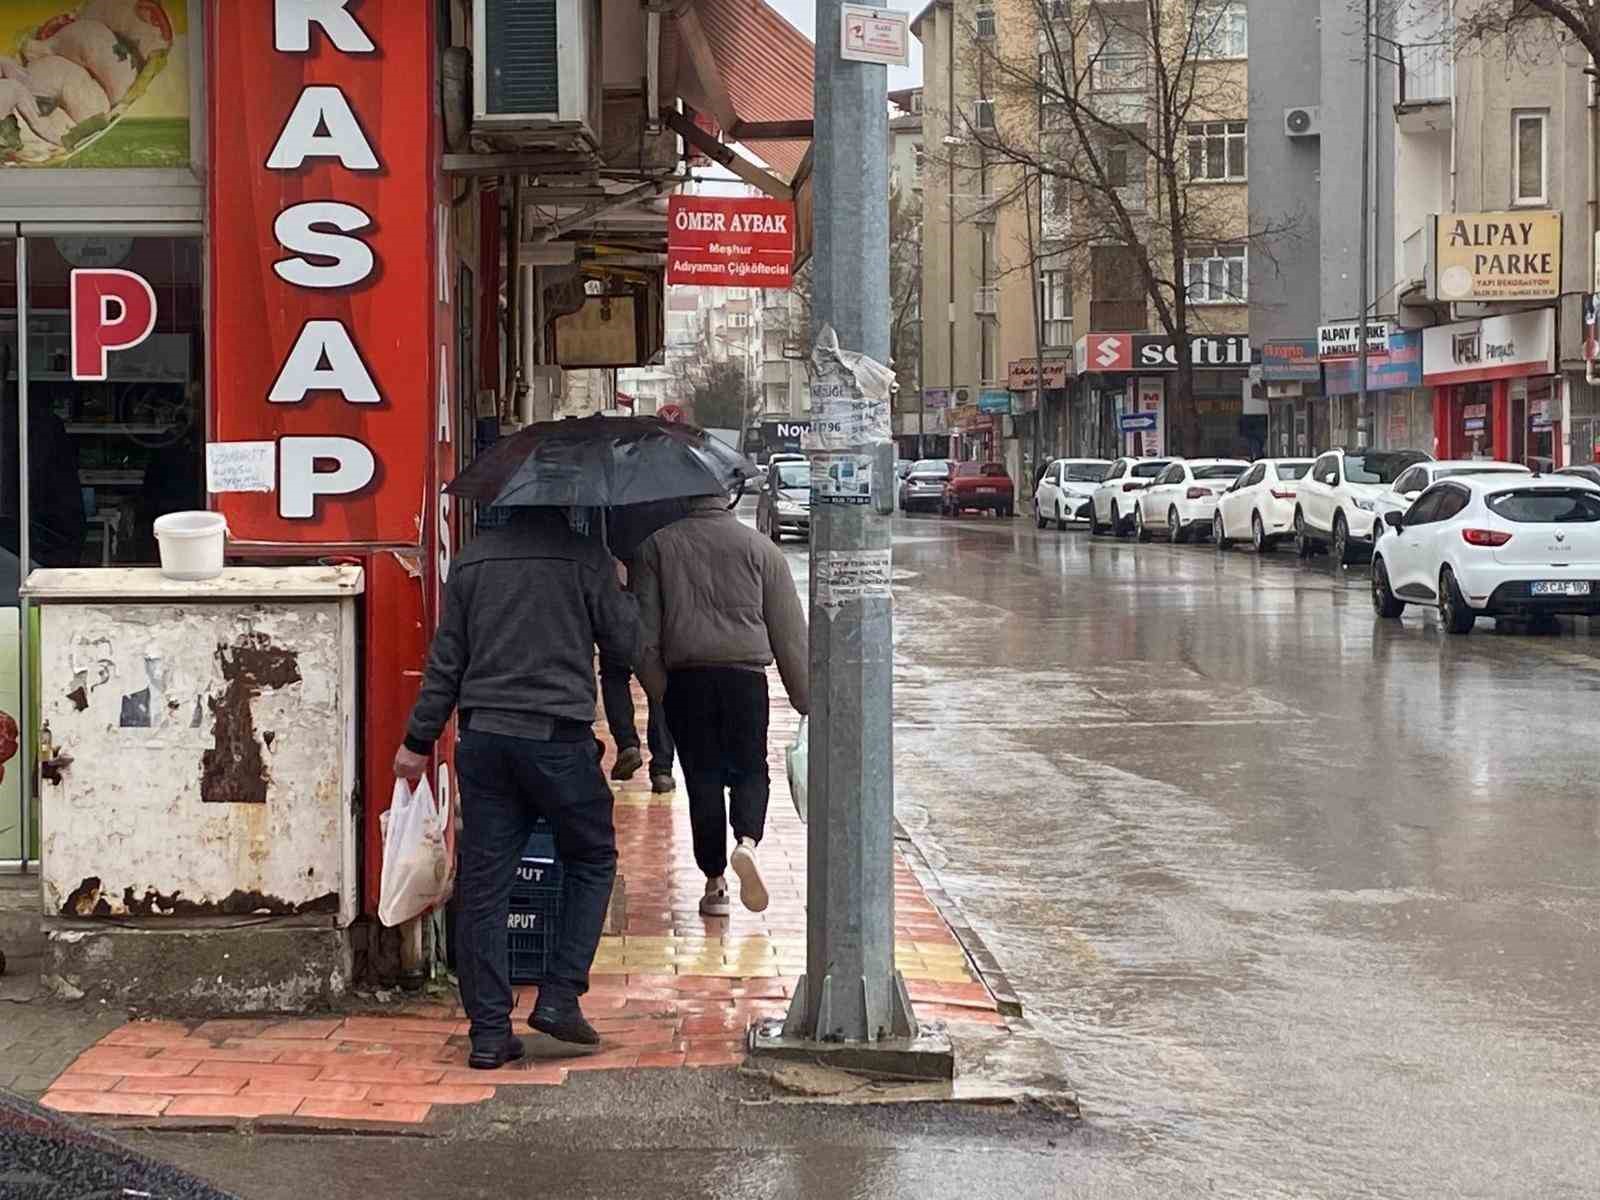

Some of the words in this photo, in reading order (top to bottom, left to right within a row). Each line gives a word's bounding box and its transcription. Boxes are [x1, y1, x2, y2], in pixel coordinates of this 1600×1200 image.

[675, 208, 726, 232] ÖMER
[729, 213, 787, 234] AYBAK
[1448, 219, 1533, 247] ALPAY
[708, 242, 753, 256] Meşhur
[673, 260, 725, 274] Adıyaman
[727, 262, 789, 276] Çiğköftecisi
[1474, 253, 1553, 275] PARKE
[70, 268, 158, 382] P
[1321, 328, 1351, 341] ALPAY
[1354, 326, 1385, 339] PRKE
